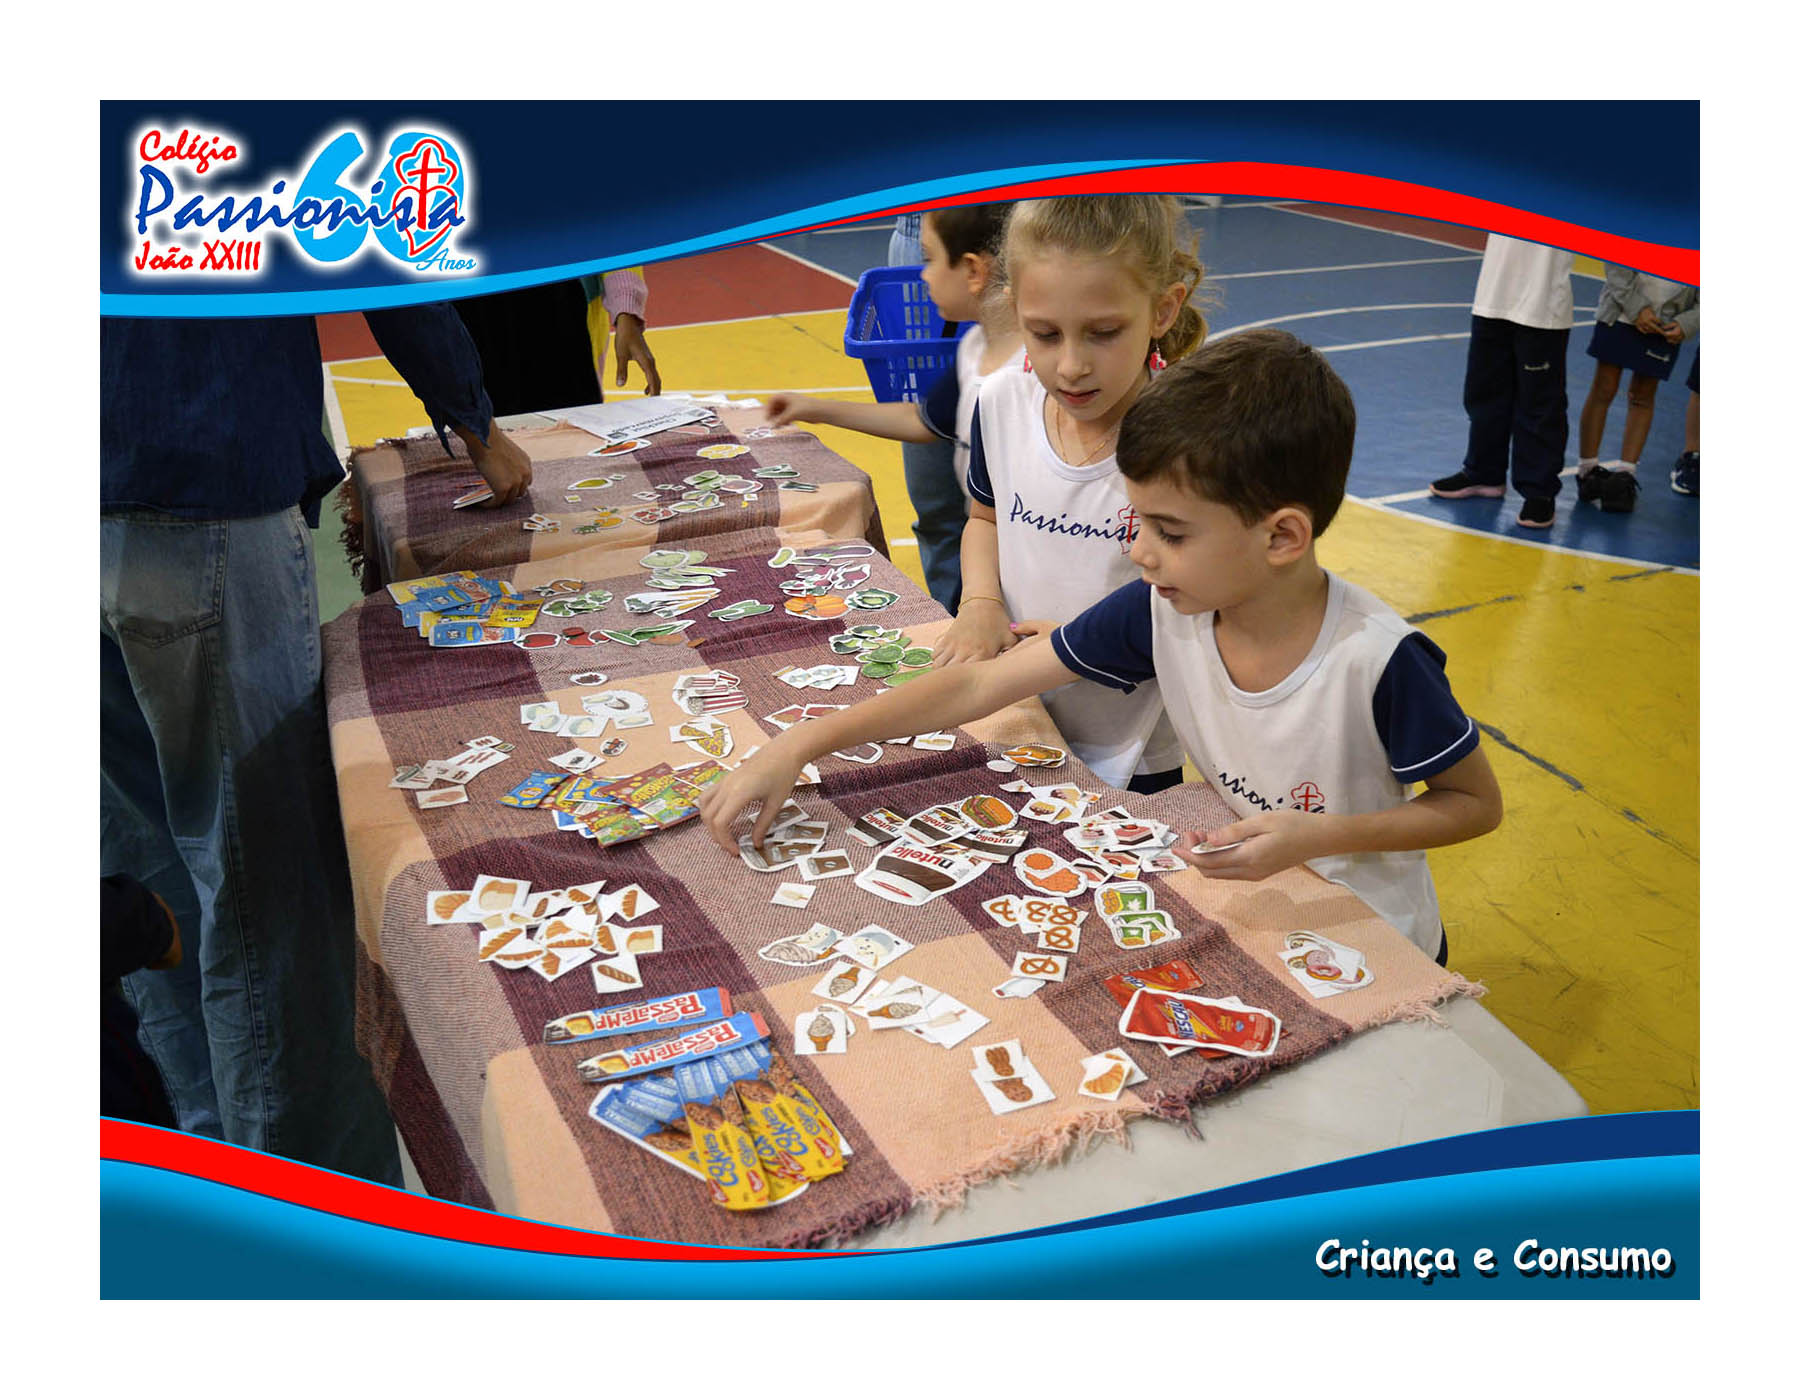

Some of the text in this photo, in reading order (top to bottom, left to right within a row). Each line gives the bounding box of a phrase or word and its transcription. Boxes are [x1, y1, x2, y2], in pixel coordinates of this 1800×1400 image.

[865, 813, 899, 833] nutella
[919, 812, 954, 832] nutella
[975, 830, 1015, 845] nutella
[891, 845, 957, 870] nutella
[1167, 998, 1196, 1039] NESCAU
